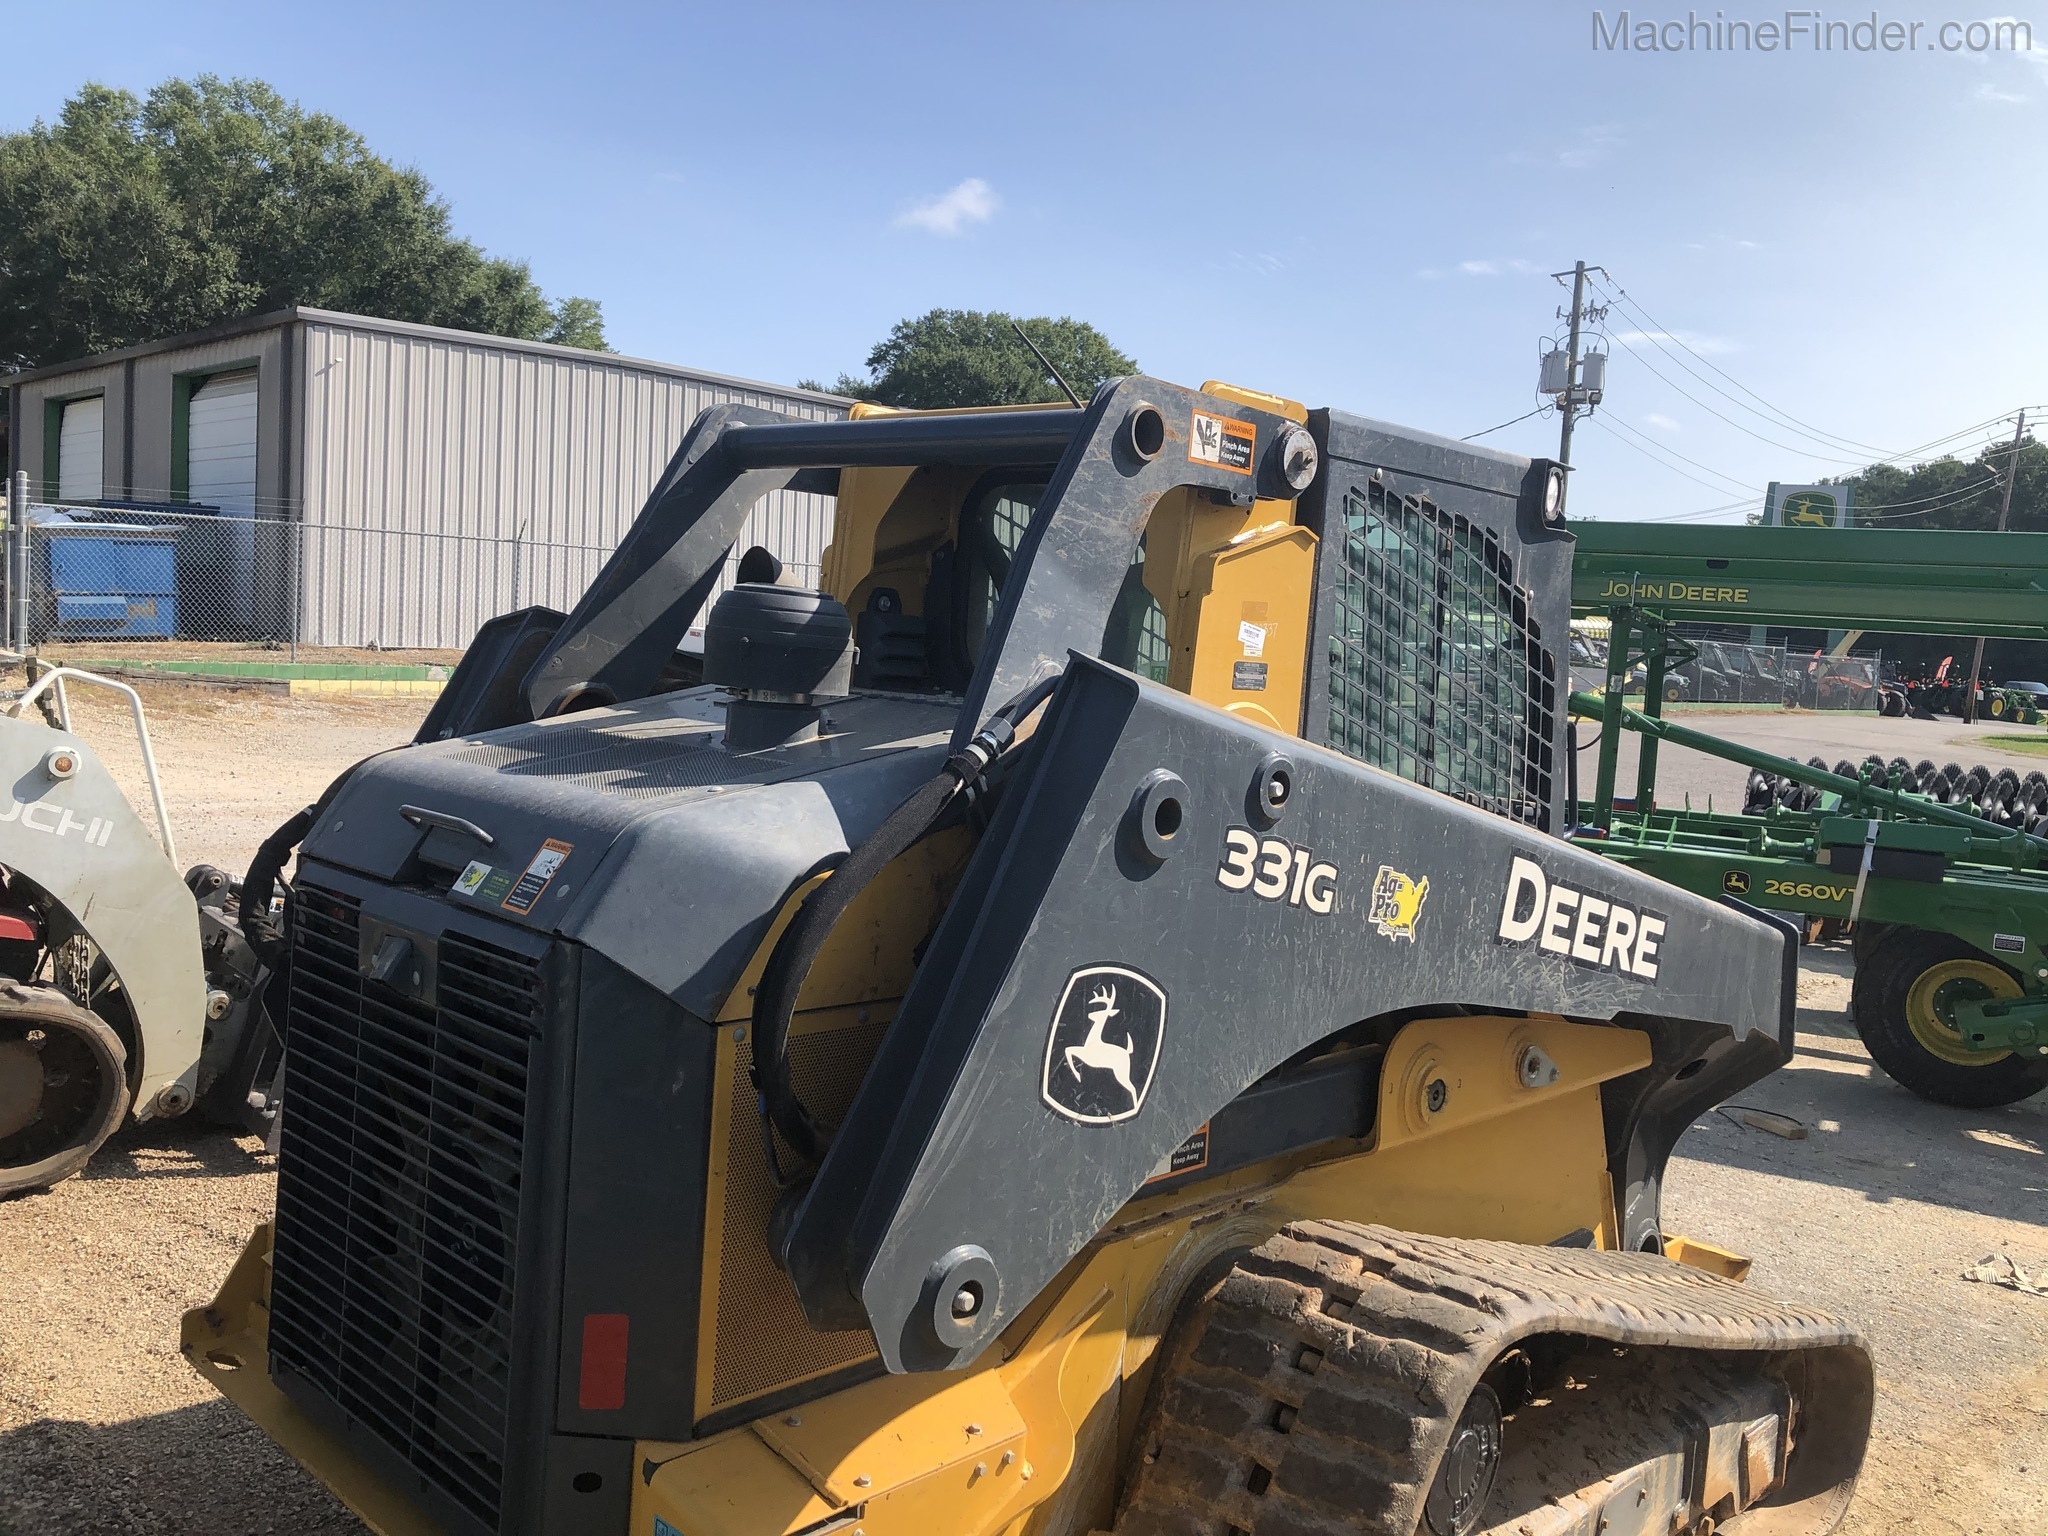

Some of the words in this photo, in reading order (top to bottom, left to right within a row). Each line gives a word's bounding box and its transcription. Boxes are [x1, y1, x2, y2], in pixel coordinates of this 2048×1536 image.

[1229, 423, 1253, 436] WARNING
[1221, 440, 1237, 451] Pinch
[1237, 444, 1250, 454] Area
[1220, 451, 1233, 461] Keep
[1233, 454, 1245, 463] Away
[1600, 580, 1664, 600] JOHN
[1668, 582, 1749, 603] DEERE
[1218, 829, 1338, 914] 331G
[1372, 894, 1400, 920] Pro
[1499, 856, 1667, 979] DEERE
[1191, 1141, 1204, 1150] Area
[1172, 1156, 1186, 1165] Keep
[1186, 1153, 1200, 1161] Away
